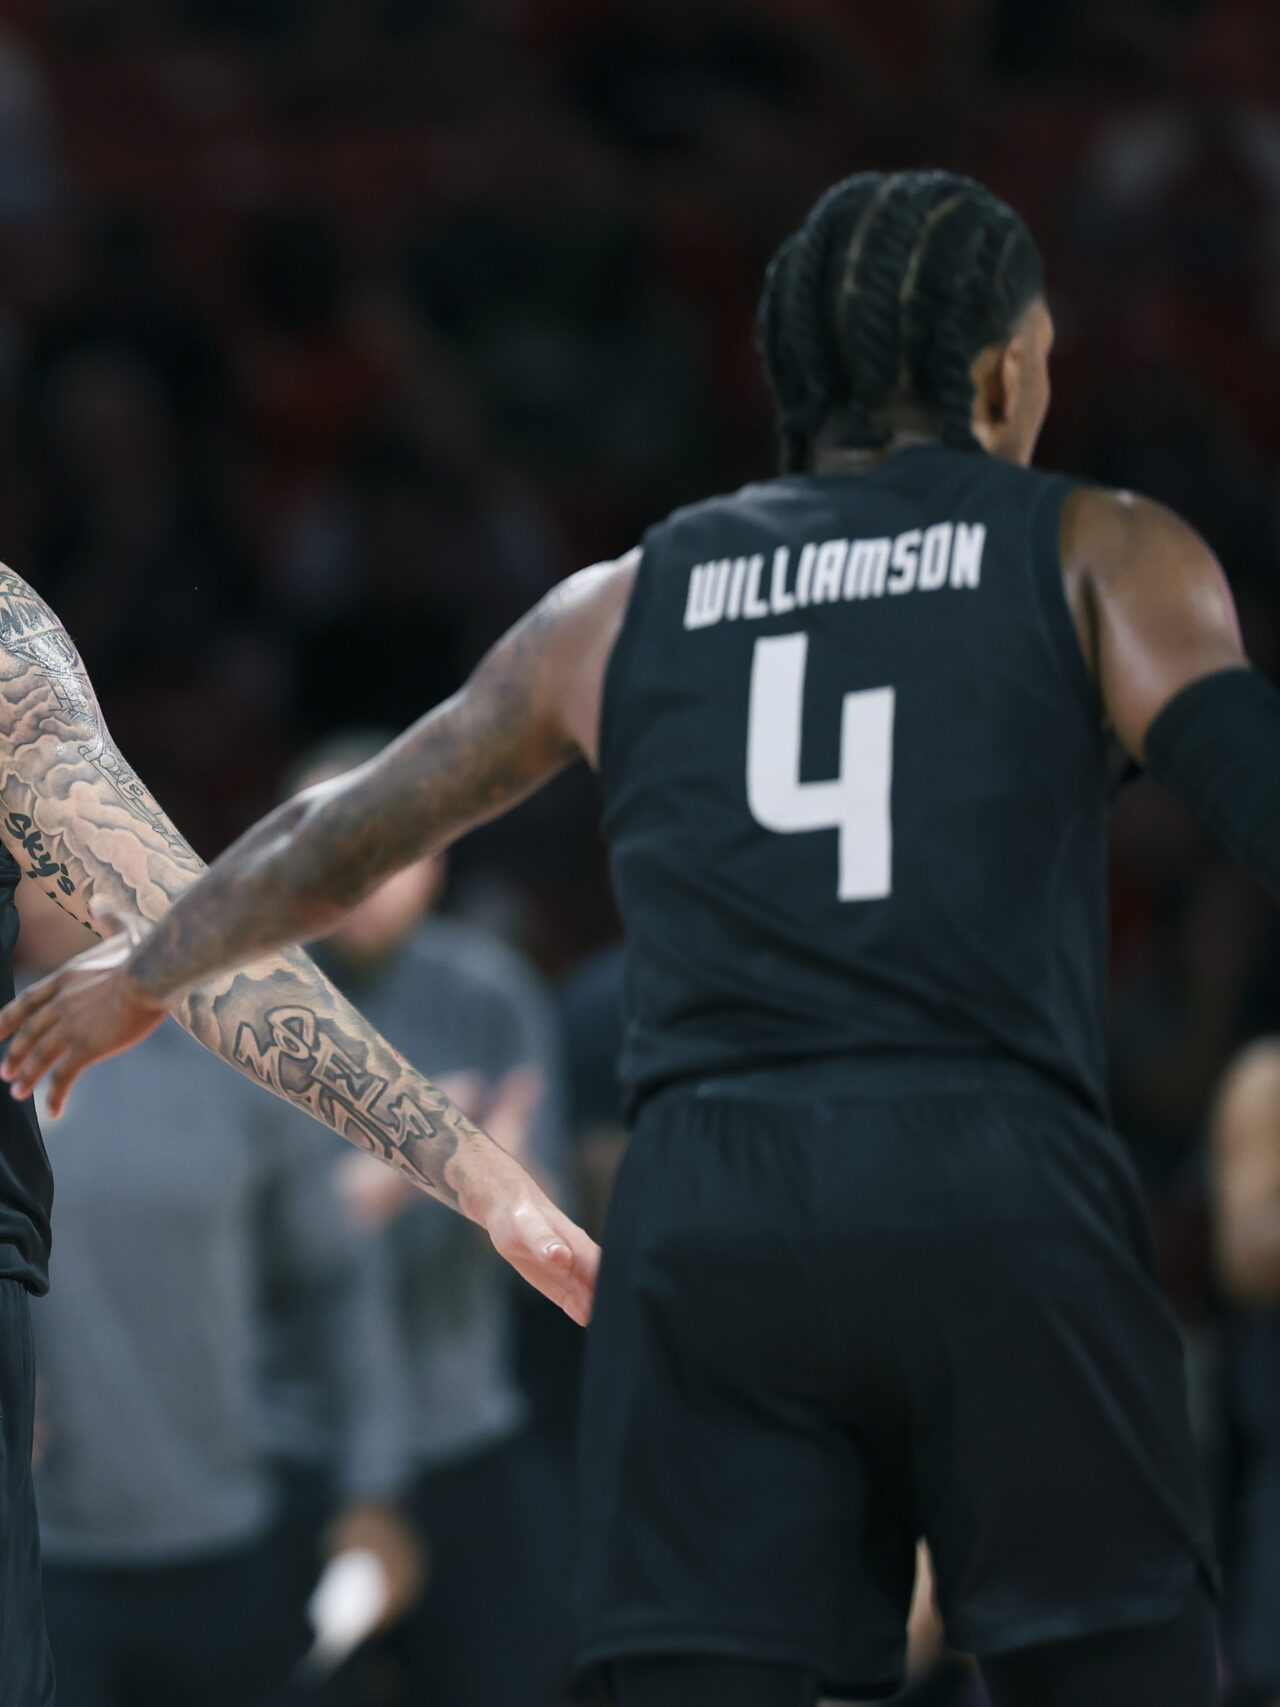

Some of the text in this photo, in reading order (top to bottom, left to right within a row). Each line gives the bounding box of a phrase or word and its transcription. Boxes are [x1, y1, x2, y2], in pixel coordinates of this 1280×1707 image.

[684, 521, 986, 631] WILLIAMSON
[746, 631, 895, 902] 4
[265, 1004, 436, 1148] SELF
